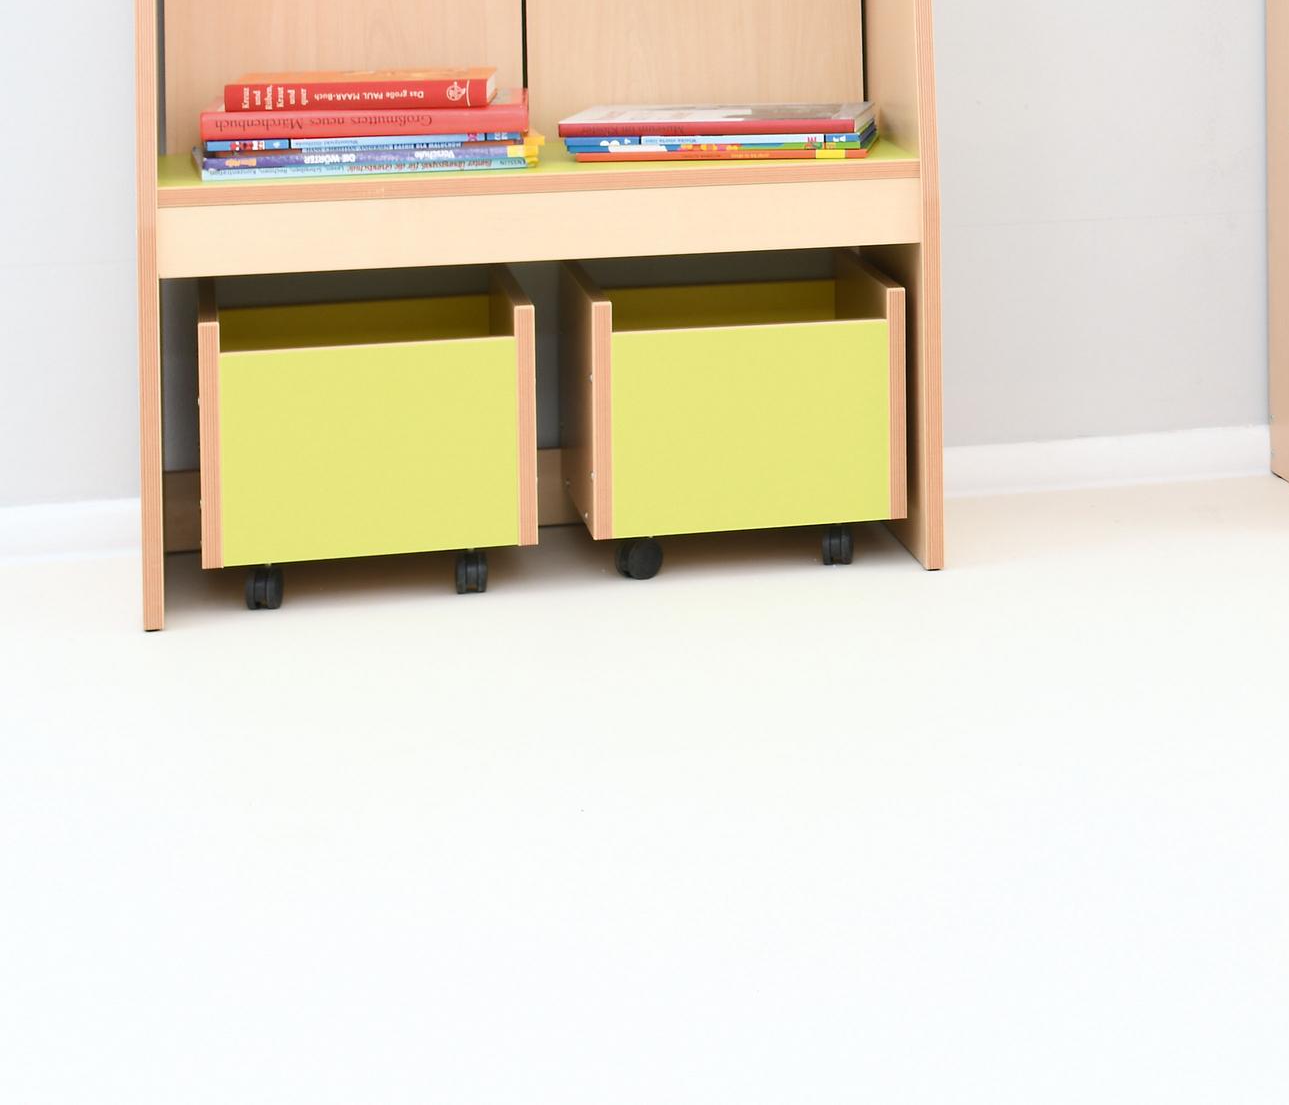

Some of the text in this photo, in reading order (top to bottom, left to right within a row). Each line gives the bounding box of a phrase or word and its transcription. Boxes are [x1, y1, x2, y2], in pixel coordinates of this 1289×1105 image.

[364, 91, 384, 101] PAUL
[386, 89, 408, 100] große
[409, 90, 425, 99] Das
[215, 114, 433, 132] Großmutters neues Märchenbuch
